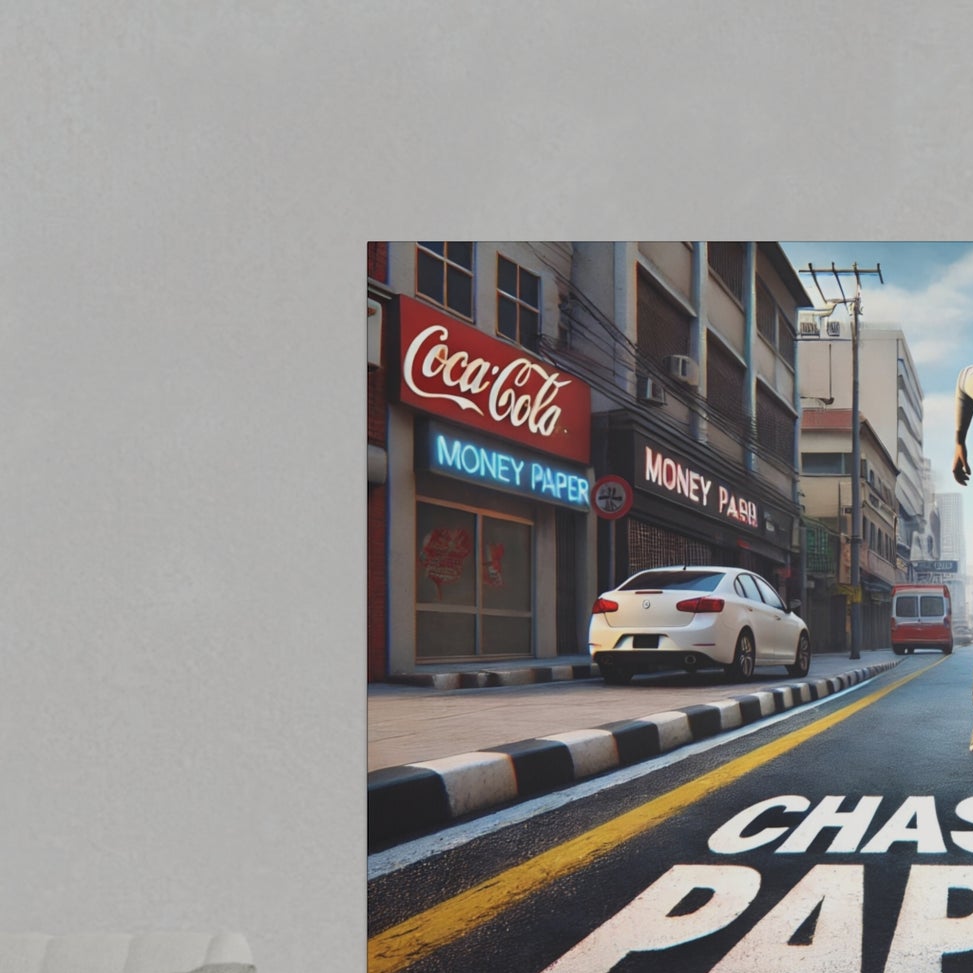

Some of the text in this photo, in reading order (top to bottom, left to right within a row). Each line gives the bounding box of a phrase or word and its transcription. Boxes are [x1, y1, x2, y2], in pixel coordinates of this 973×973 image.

[437, 435, 590, 503] MONEY PAPER
[645, 446, 711, 506] MONEY
